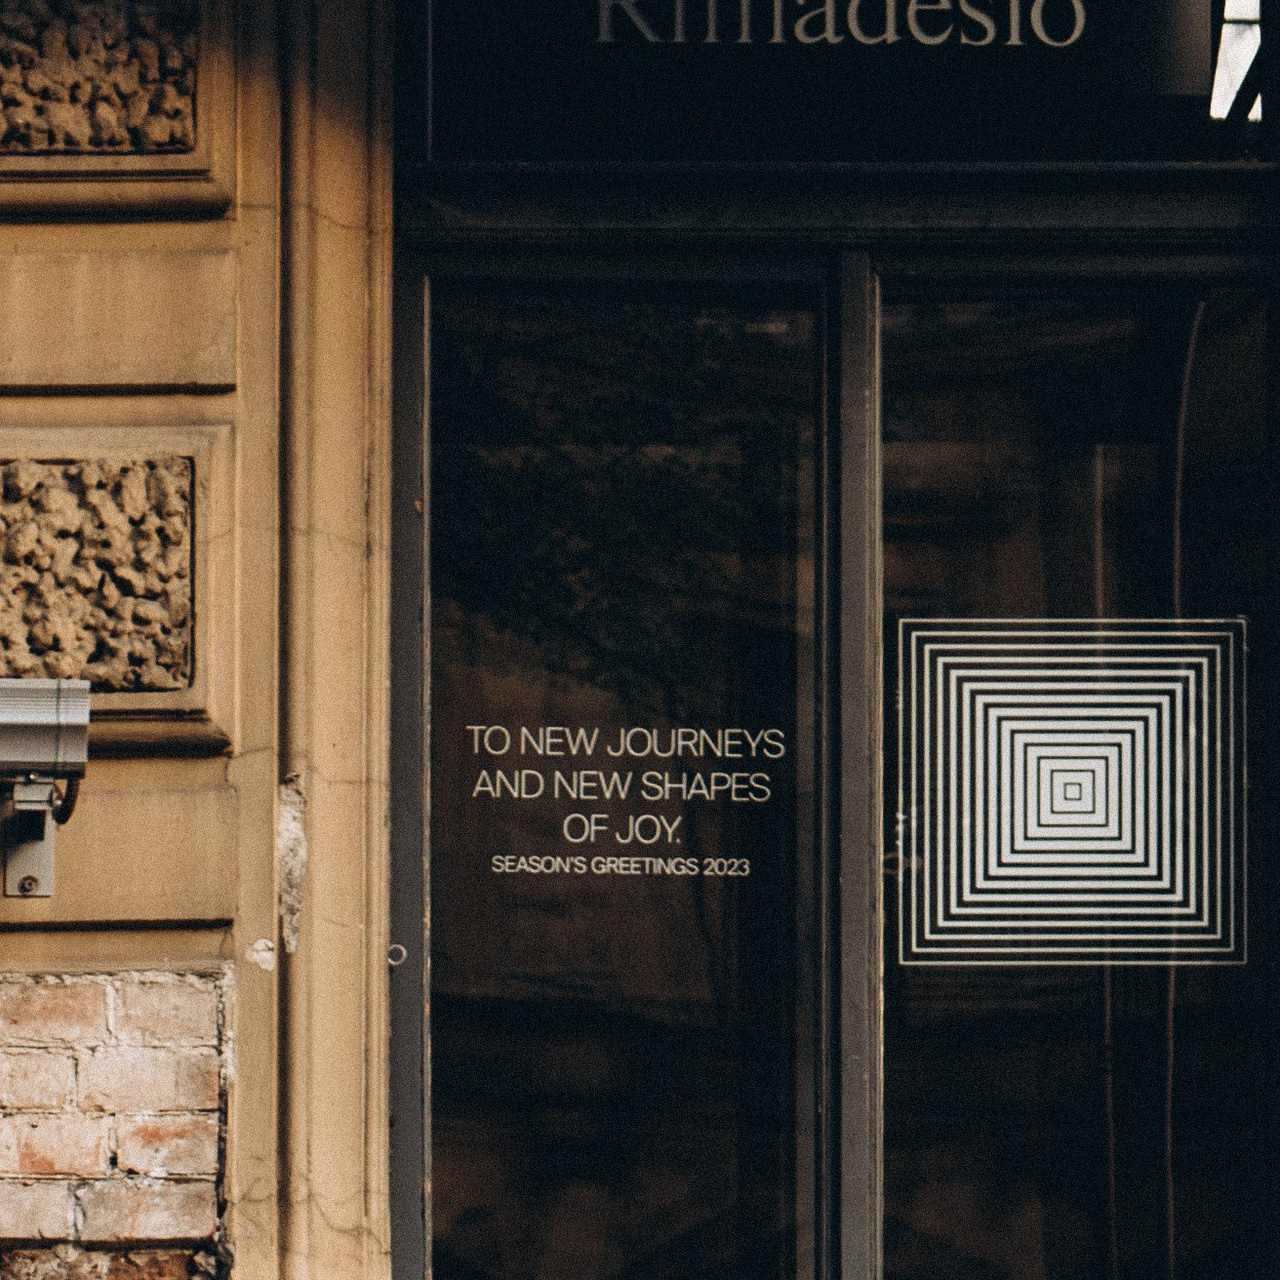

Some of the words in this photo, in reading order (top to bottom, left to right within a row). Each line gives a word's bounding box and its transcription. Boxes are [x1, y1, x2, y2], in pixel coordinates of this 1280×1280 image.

[466, 725, 510, 755] TO
[520, 726, 599, 756] NEW
[606, 727, 785, 758] JOURNEYS
[472, 769, 545, 799] AND
[554, 770, 633, 800] NEW
[641, 770, 771, 802] SHAPES
[563, 813, 609, 843] OF
[615, 814, 682, 845] JOY.
[491, 855, 587, 874] SEASON'S
[590, 856, 699, 876] GREETINGS
[703, 858, 750, 876] 2023
